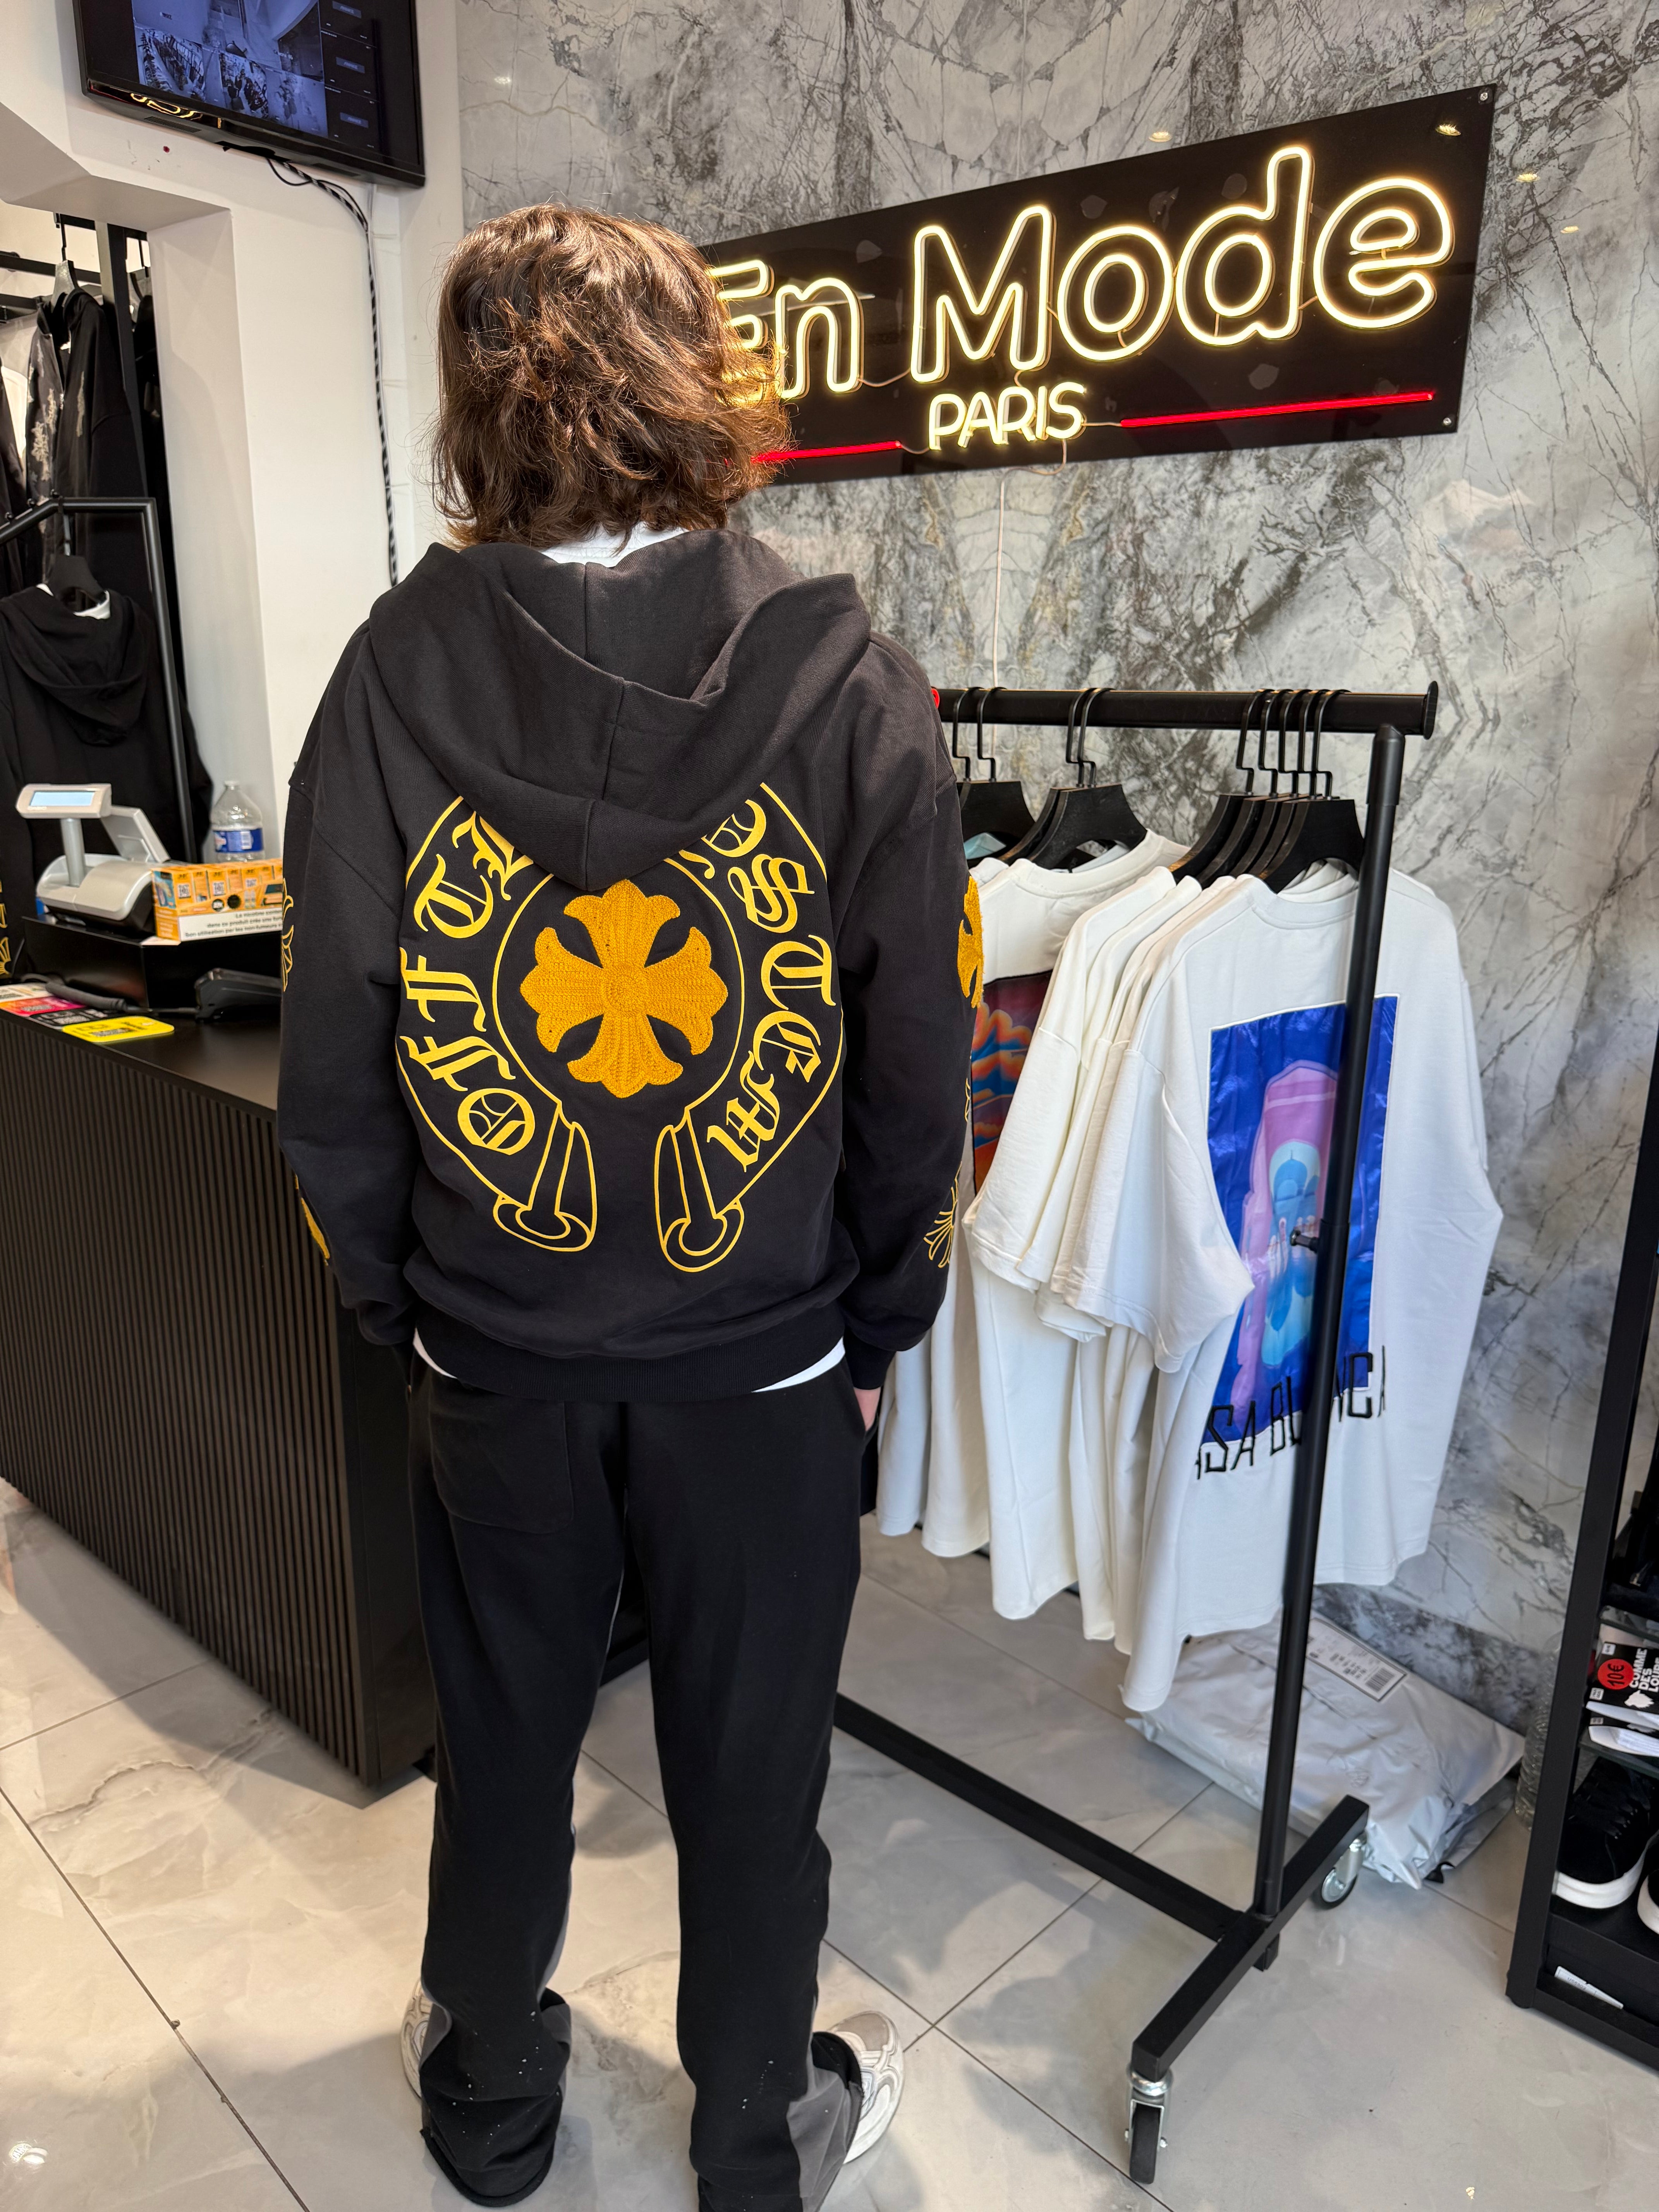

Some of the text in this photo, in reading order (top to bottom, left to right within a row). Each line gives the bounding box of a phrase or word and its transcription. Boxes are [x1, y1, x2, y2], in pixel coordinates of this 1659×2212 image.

[911, 146, 1454, 383] Mode
[929, 381, 1086, 450] PARIS
[399, 947, 535, 1155] OFF
[1607, 1663, 1625, 1686] 10€
[1629, 1648, 1647, 1689] COMME
[1638, 1668, 1652, 1691] DES
